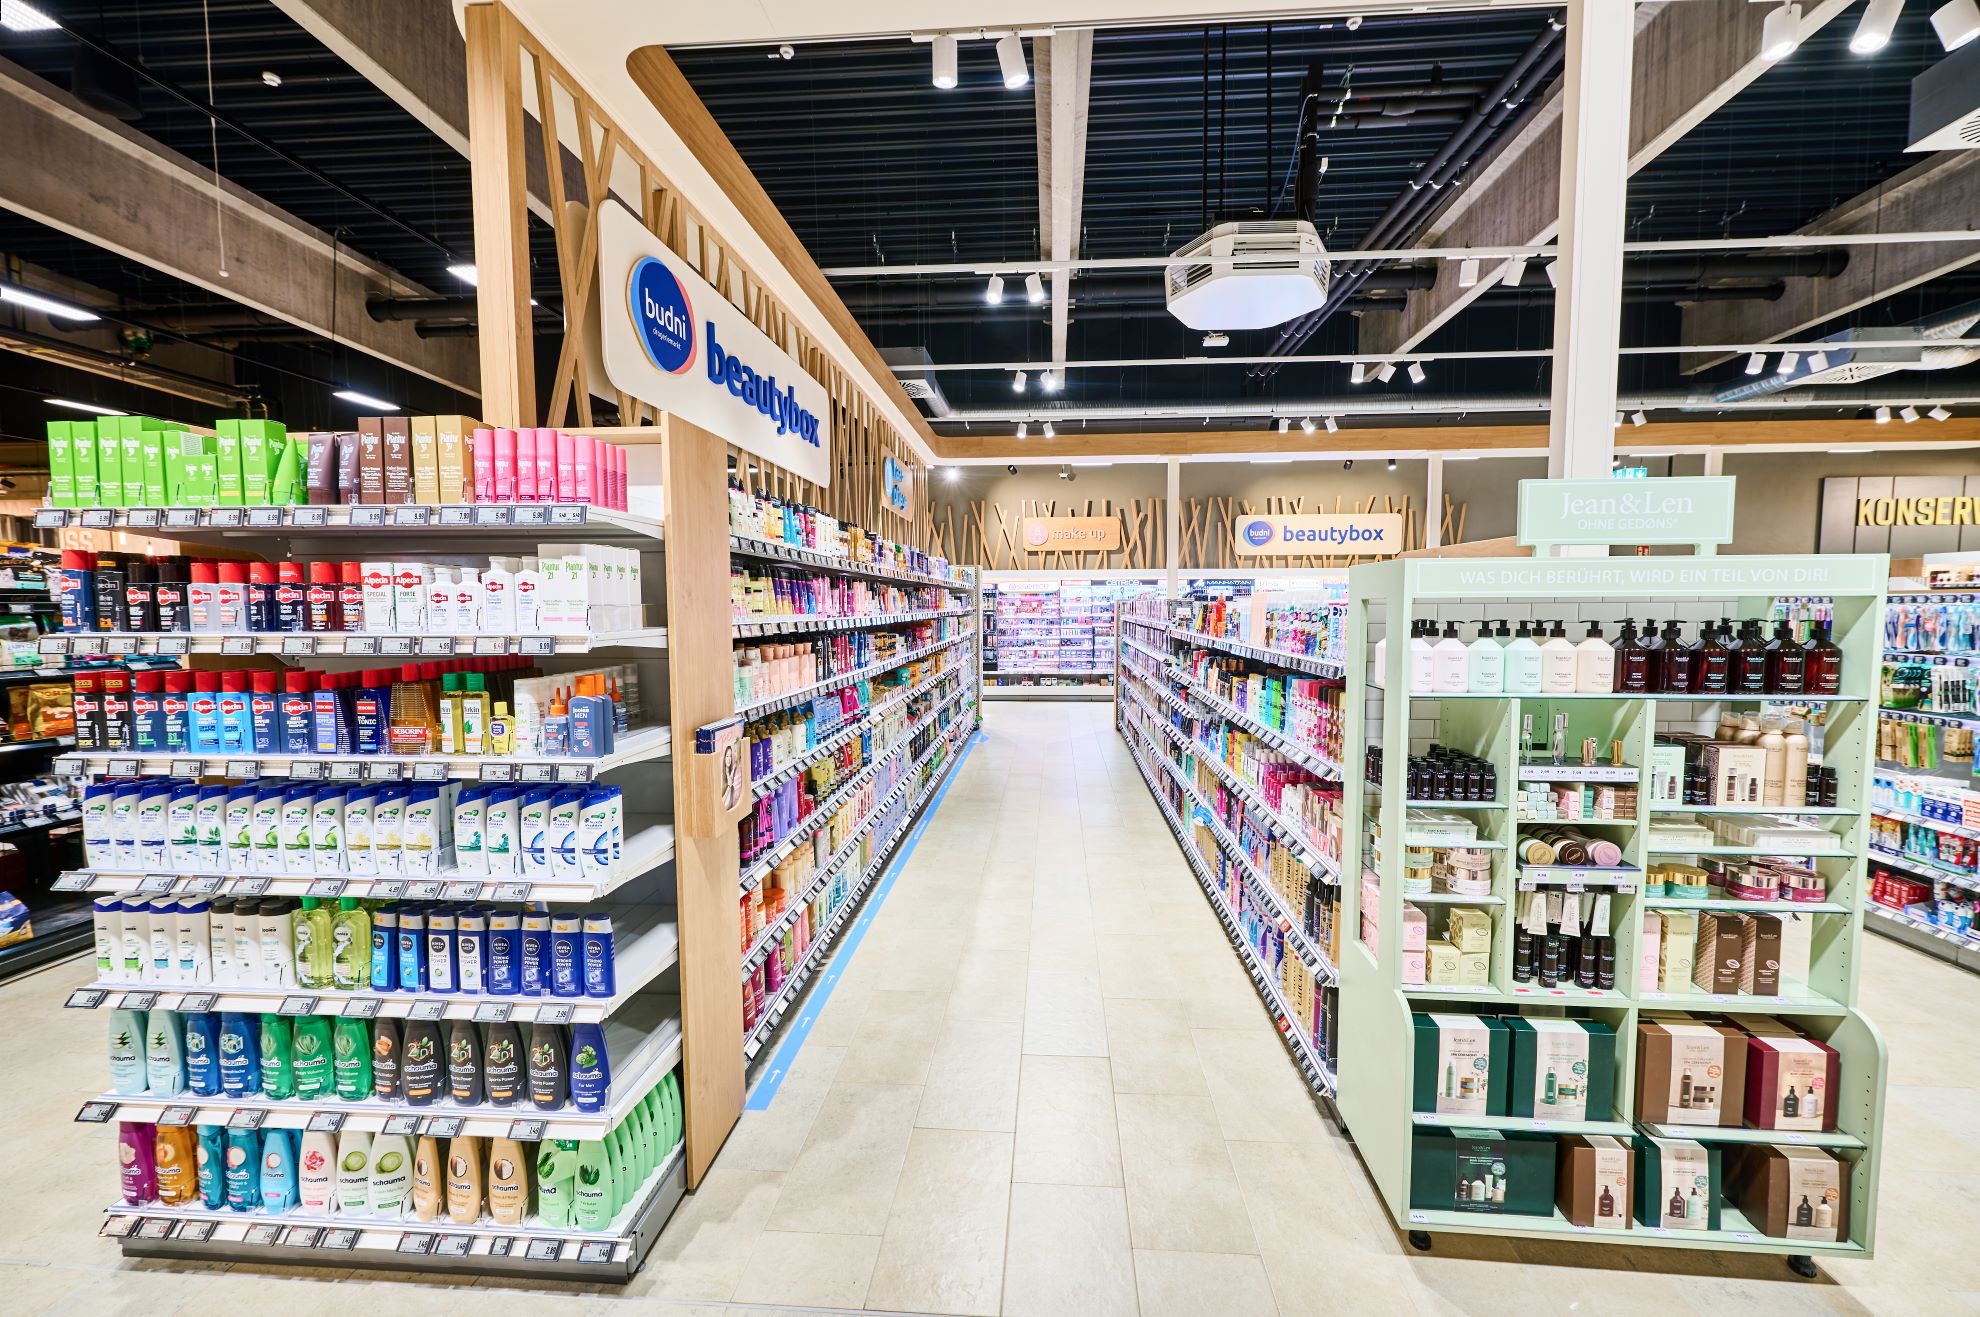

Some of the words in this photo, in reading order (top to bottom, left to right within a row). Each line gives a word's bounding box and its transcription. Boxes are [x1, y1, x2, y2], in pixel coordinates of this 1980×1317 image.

[645, 288, 687, 341] budni
[706, 321, 821, 449] beautybox
[1578, 519, 1615, 531] OHNE
[1052, 528, 1088, 540] make
[1090, 529, 1107, 542] up
[1283, 525, 1385, 545] beautybox
[542, 562, 560, 572] Plantur
[566, 561, 584, 572] Plantur
[548, 572, 554, 580] 21
[572, 572, 578, 580] 21
[1460, 571, 1497, 586] WAS
[1501, 570, 1542, 585] DICH
[1546, 567, 1626, 586] BERÜHRT,
[1630, 569, 1675, 584] WIRD
[1680, 569, 1709, 583] EIN
[1712, 569, 1746, 583] TEIL
[1751, 569, 1790, 583] VON
[1794, 568, 1830, 583] DIR!
[294, 1058, 327, 1068] schauma
[404, 1062, 438, 1073] schauma
[373, 1176, 406, 1187] schauma
[492, 1183, 519, 1192] schauma
